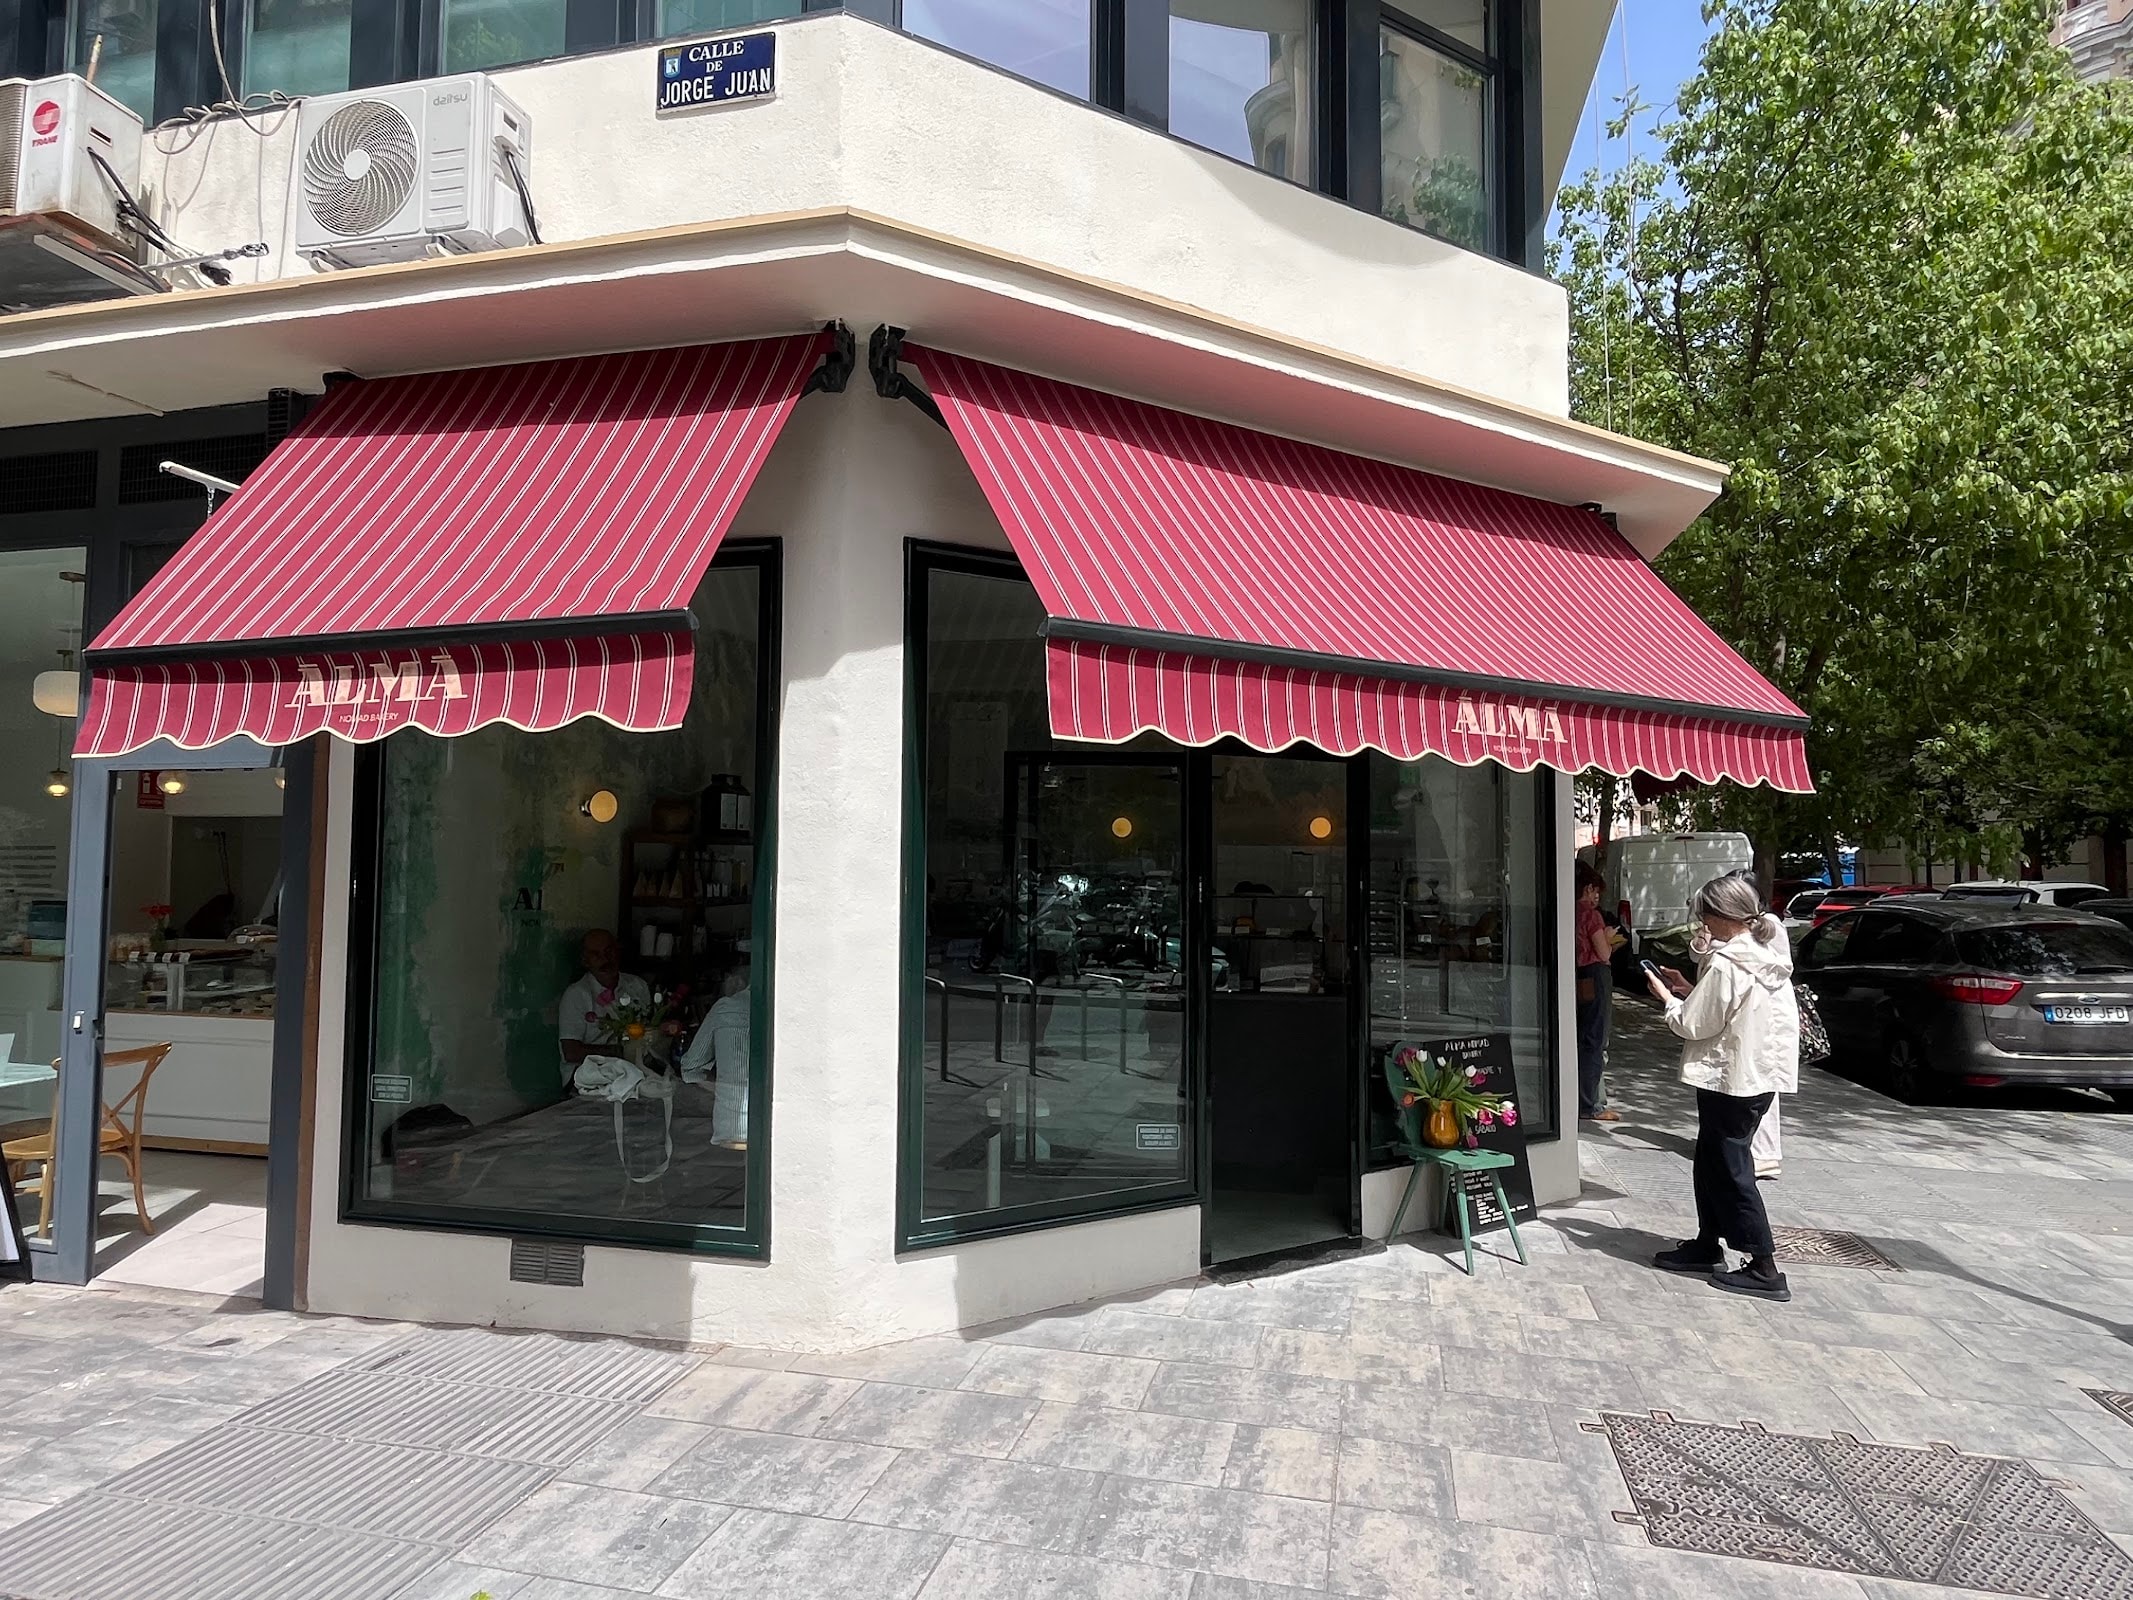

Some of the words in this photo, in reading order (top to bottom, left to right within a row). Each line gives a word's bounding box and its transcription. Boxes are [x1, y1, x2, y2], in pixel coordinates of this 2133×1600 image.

[689, 40, 745, 62] CALLE
[706, 60, 723, 73] DE
[660, 76, 714, 106] JORGE
[725, 67, 771, 96] JUAN
[339, 714, 369, 723] NOAD
[369, 712, 399, 722] BAERY
[2055, 1007, 2092, 1019] 0208
[2100, 1007, 2125, 1019] JFD
